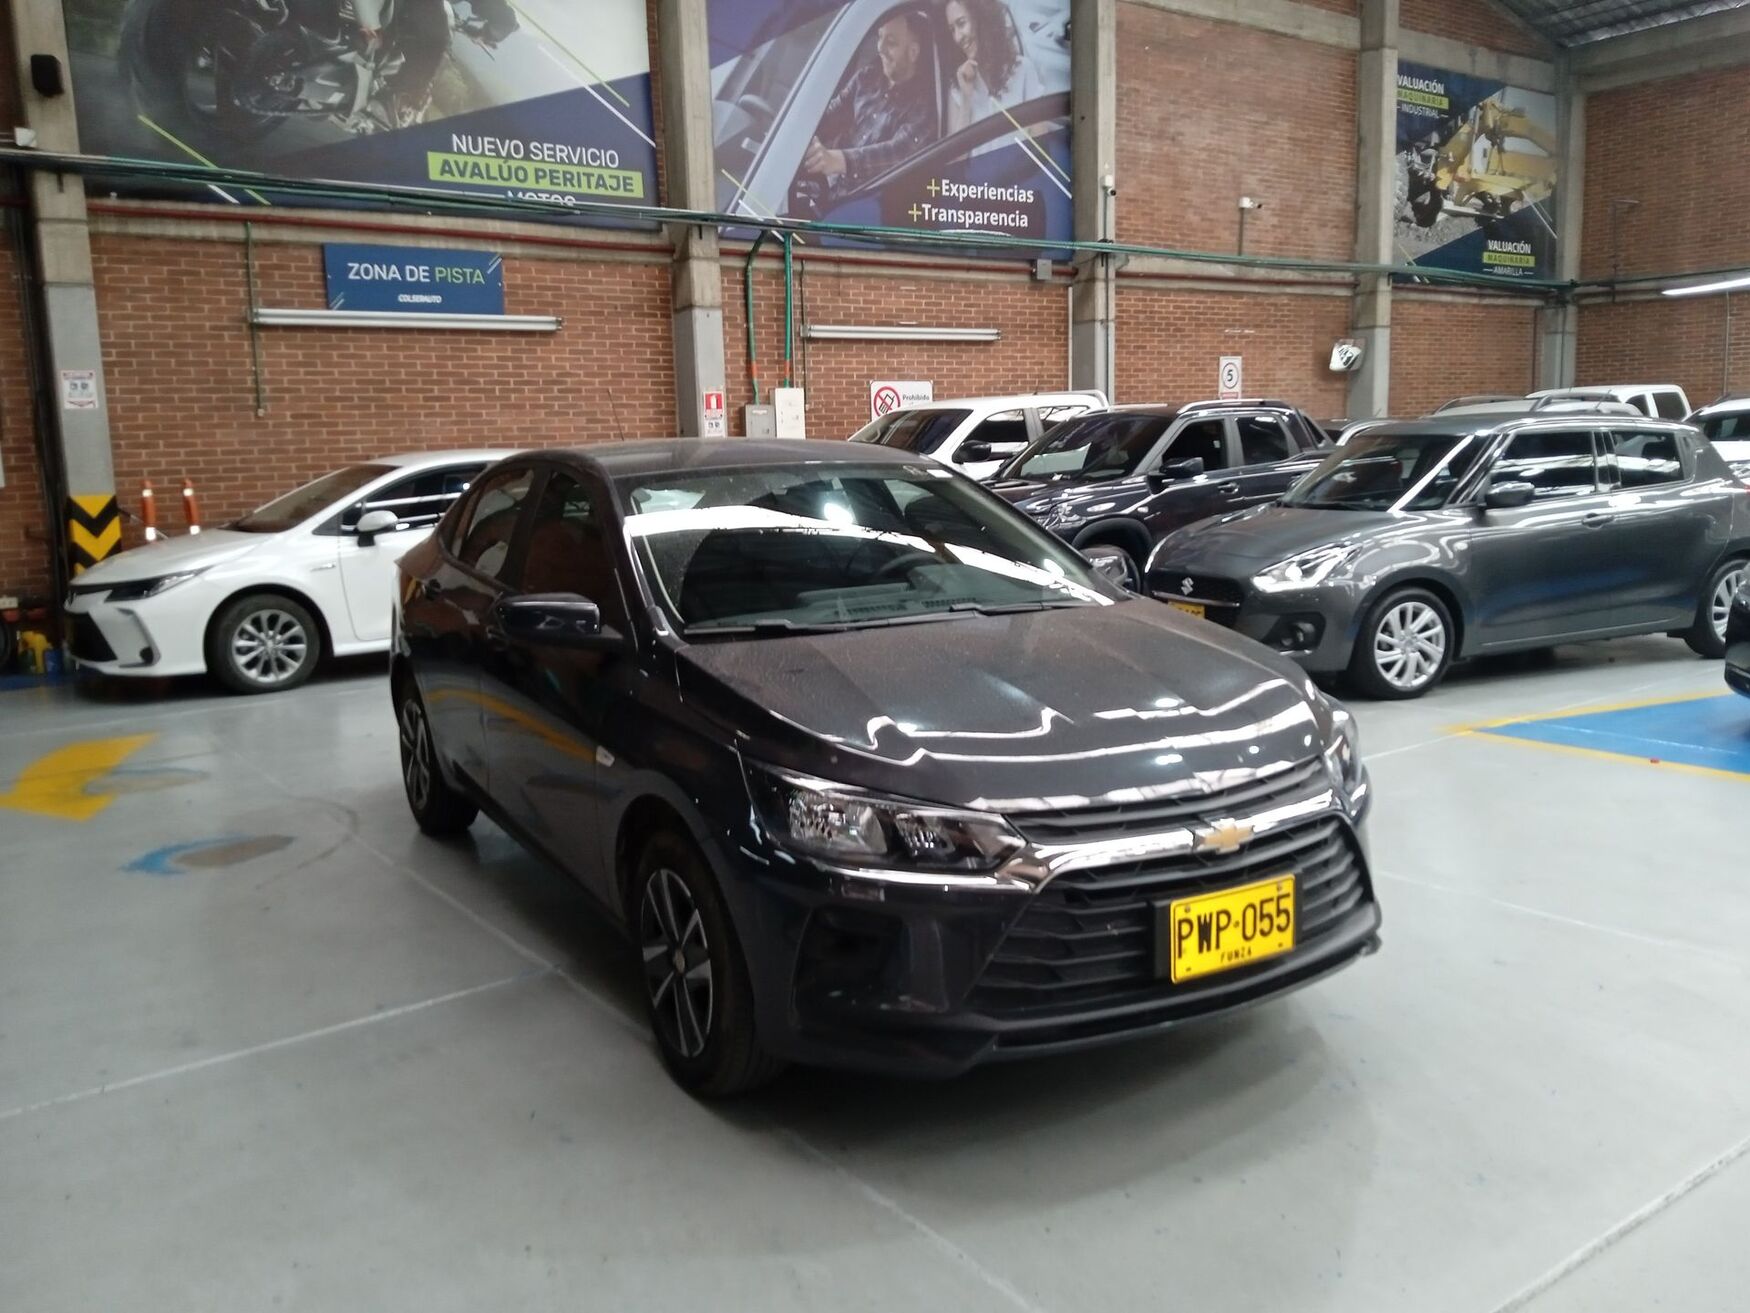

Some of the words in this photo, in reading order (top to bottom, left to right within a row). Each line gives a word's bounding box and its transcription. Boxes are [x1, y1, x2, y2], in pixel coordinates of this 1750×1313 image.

[1397, 74, 1445, 95] VALUACIÓN
[452, 133, 525, 160] NUEVO
[529, 141, 619, 168] SERVICIO
[439, 158, 529, 184] AVALÚO
[534, 166, 635, 193] PERITAJE
[1487, 239, 1532, 254] VALUACIÓN
[347, 262, 402, 281] ZONA
[405, 265, 431, 282] DE
[434, 266, 486, 285] PISTA
[1226, 369, 1234, 382] 5
[902, 393, 930, 401] Prohibido
[1220, 946, 1252, 963] FUNZA
